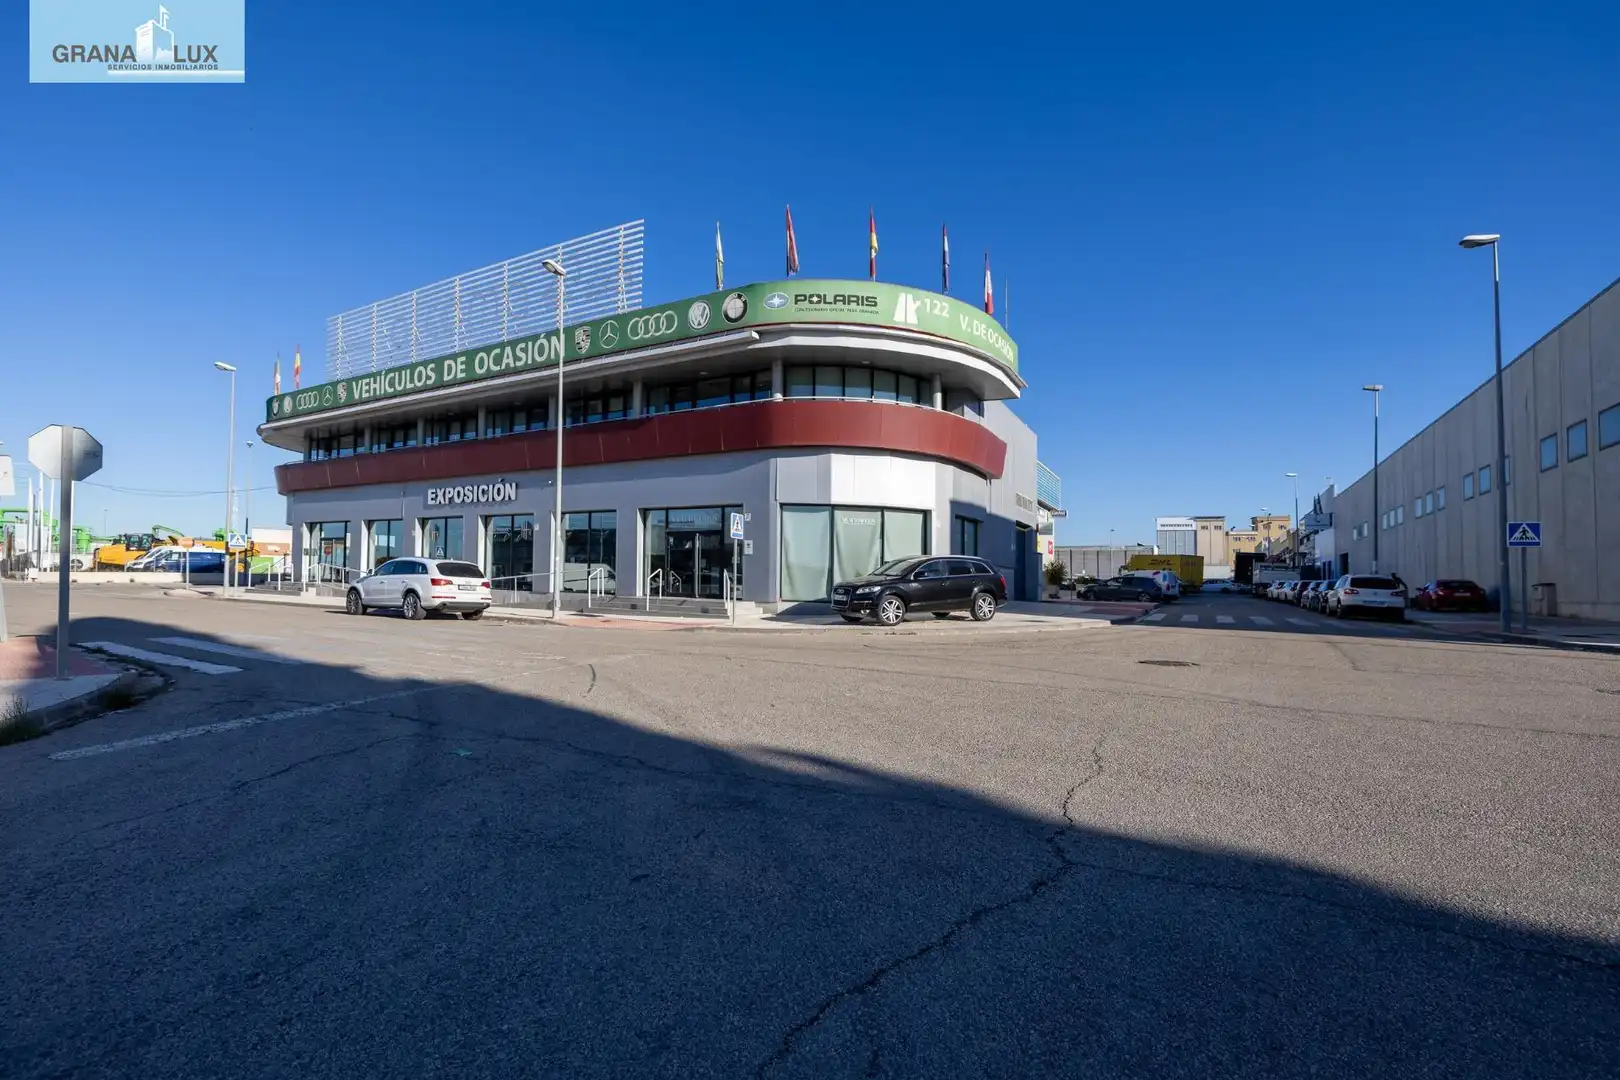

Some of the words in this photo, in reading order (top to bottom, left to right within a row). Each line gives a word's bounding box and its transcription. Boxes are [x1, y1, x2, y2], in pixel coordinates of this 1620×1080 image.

[794, 293, 878, 307] POLARIS
[924, 298, 950, 318] 122
[960, 313, 971, 332] V.
[973, 319, 987, 341] DE
[987, 328, 1014, 363] OCASIÓN
[352, 363, 436, 399] VEHÍCULOS
[443, 356, 470, 381] DE
[474, 333, 565, 374] OCASIÓN
[427, 477, 517, 505] EXPOSICIÓN
